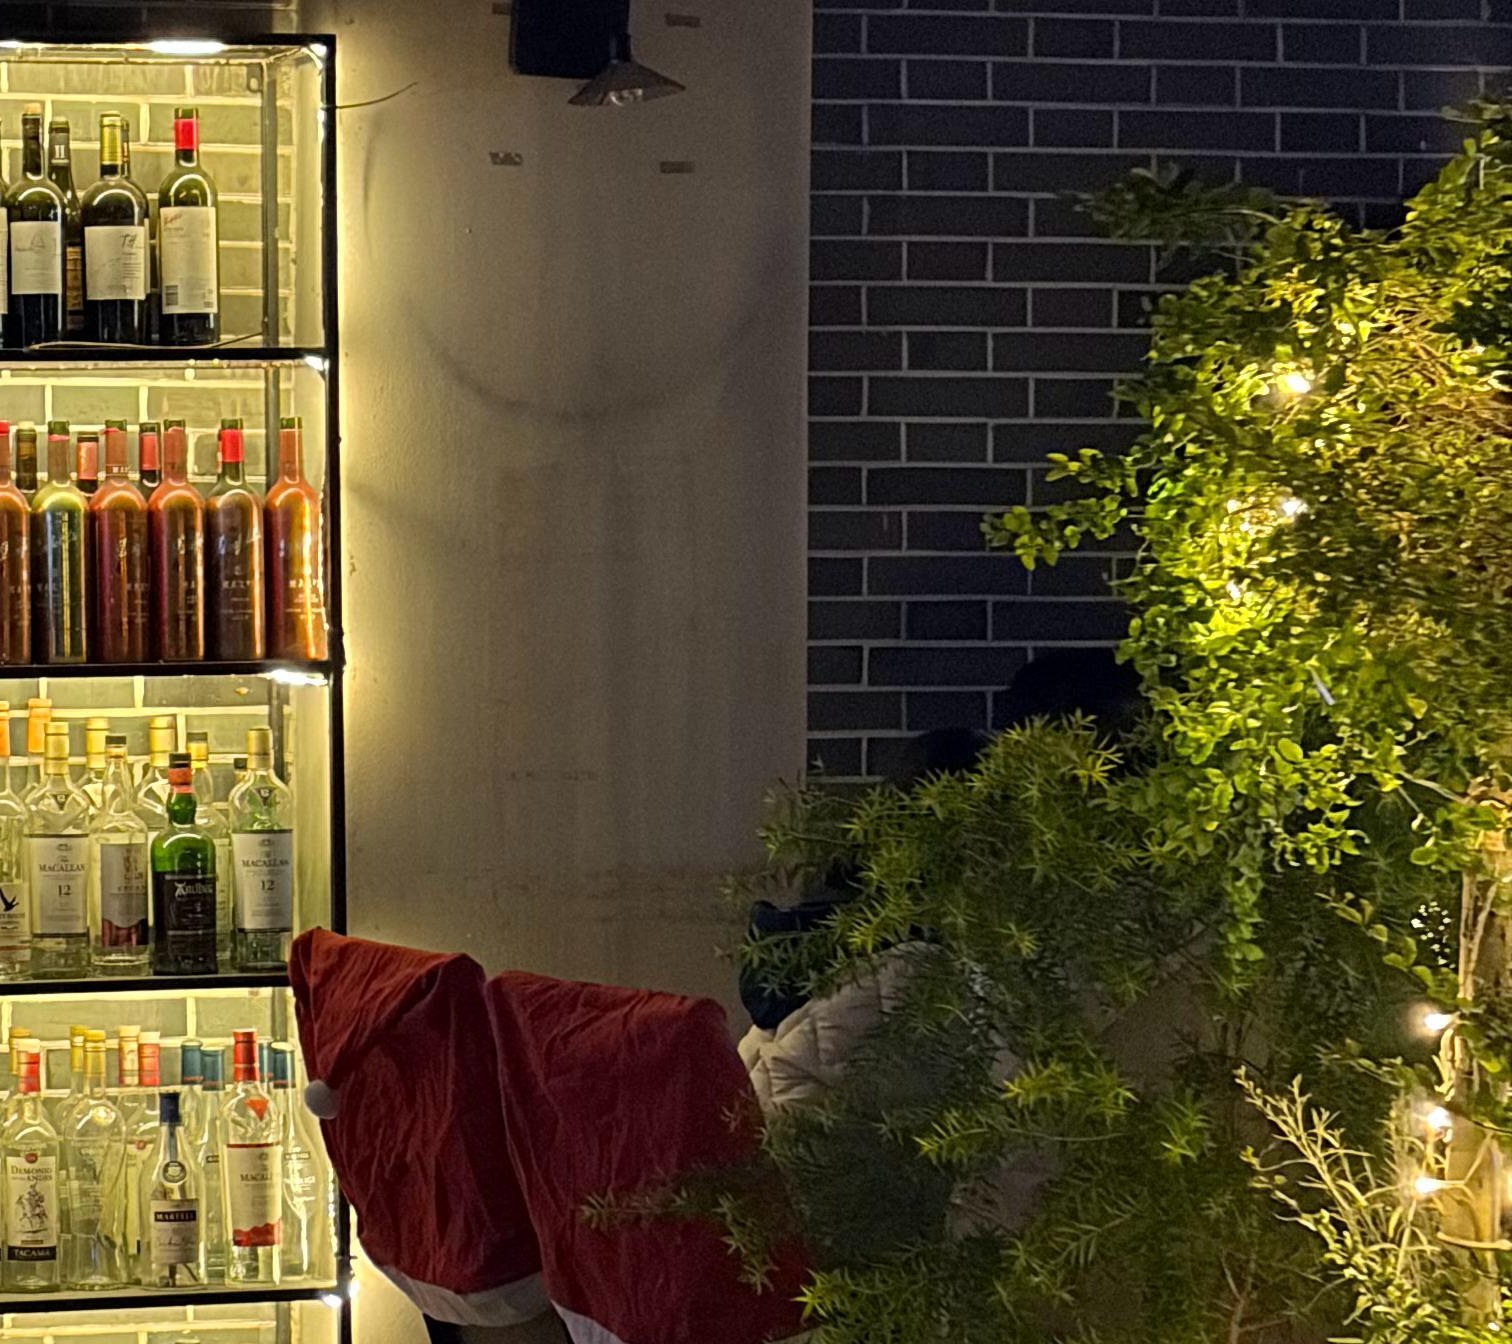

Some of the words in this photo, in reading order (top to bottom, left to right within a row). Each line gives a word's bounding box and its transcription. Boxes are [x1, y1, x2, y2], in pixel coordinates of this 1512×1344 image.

[40, 863, 85, 872] MACALLAN
[57, 884, 71, 897] 12
[261, 879, 275, 892] 12
